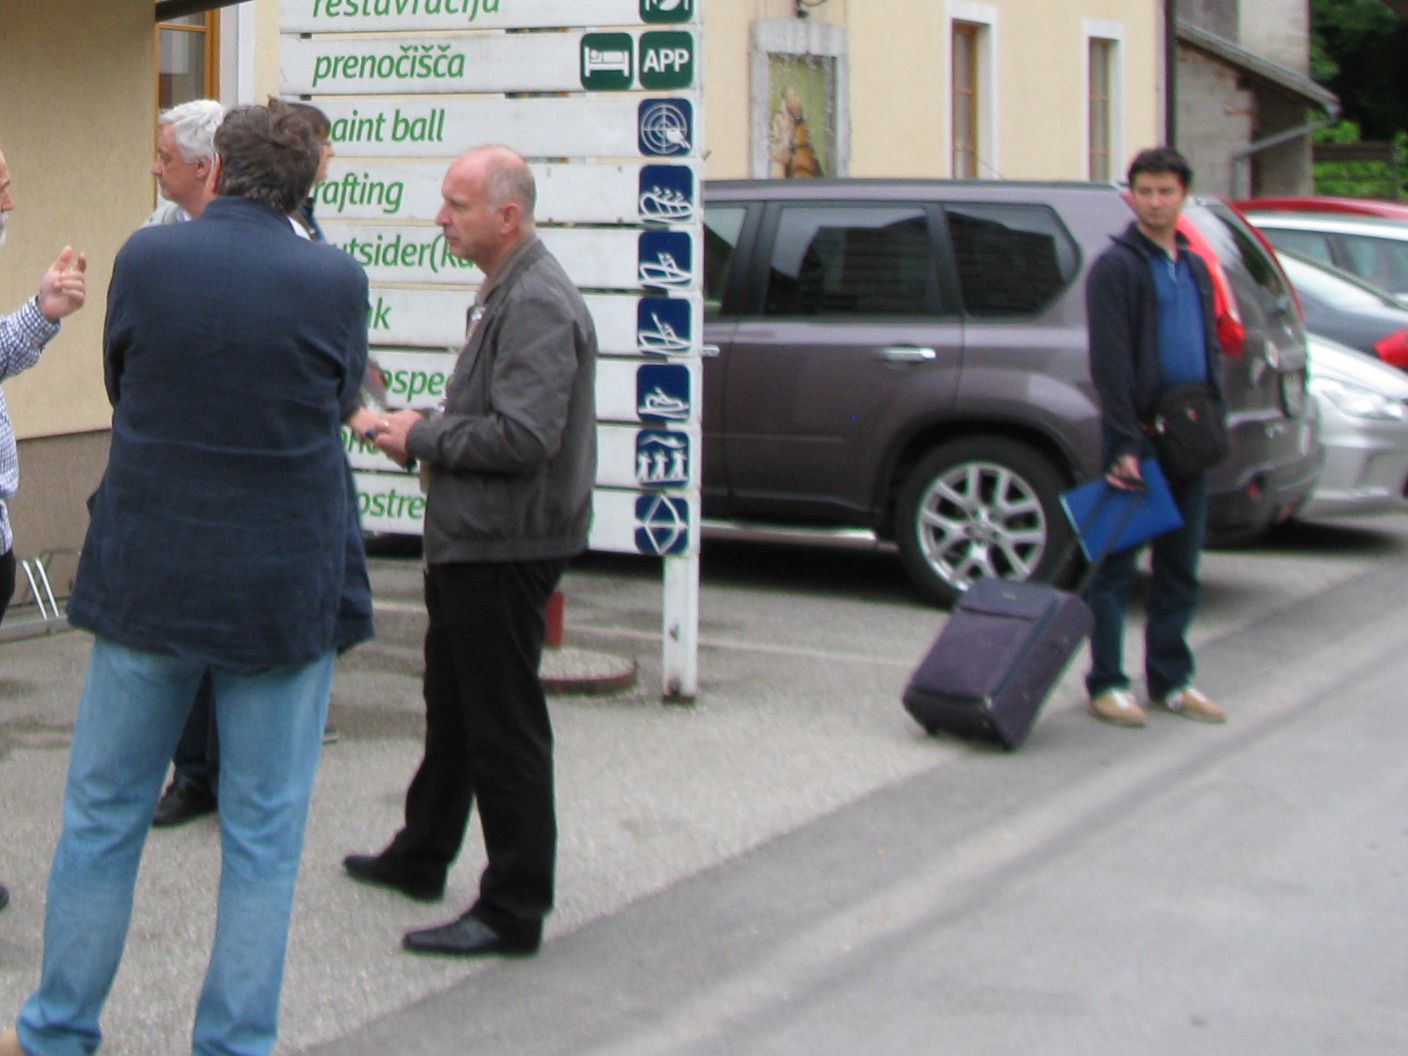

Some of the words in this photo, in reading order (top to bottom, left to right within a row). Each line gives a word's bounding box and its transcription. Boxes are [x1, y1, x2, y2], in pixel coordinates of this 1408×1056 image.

[312, 44, 466, 87] prenočišča
[642, 48, 690, 73] APP
[329, 110, 386, 142] aint
[391, 108, 446, 142] ball
[313, 172, 403, 215] rafting
